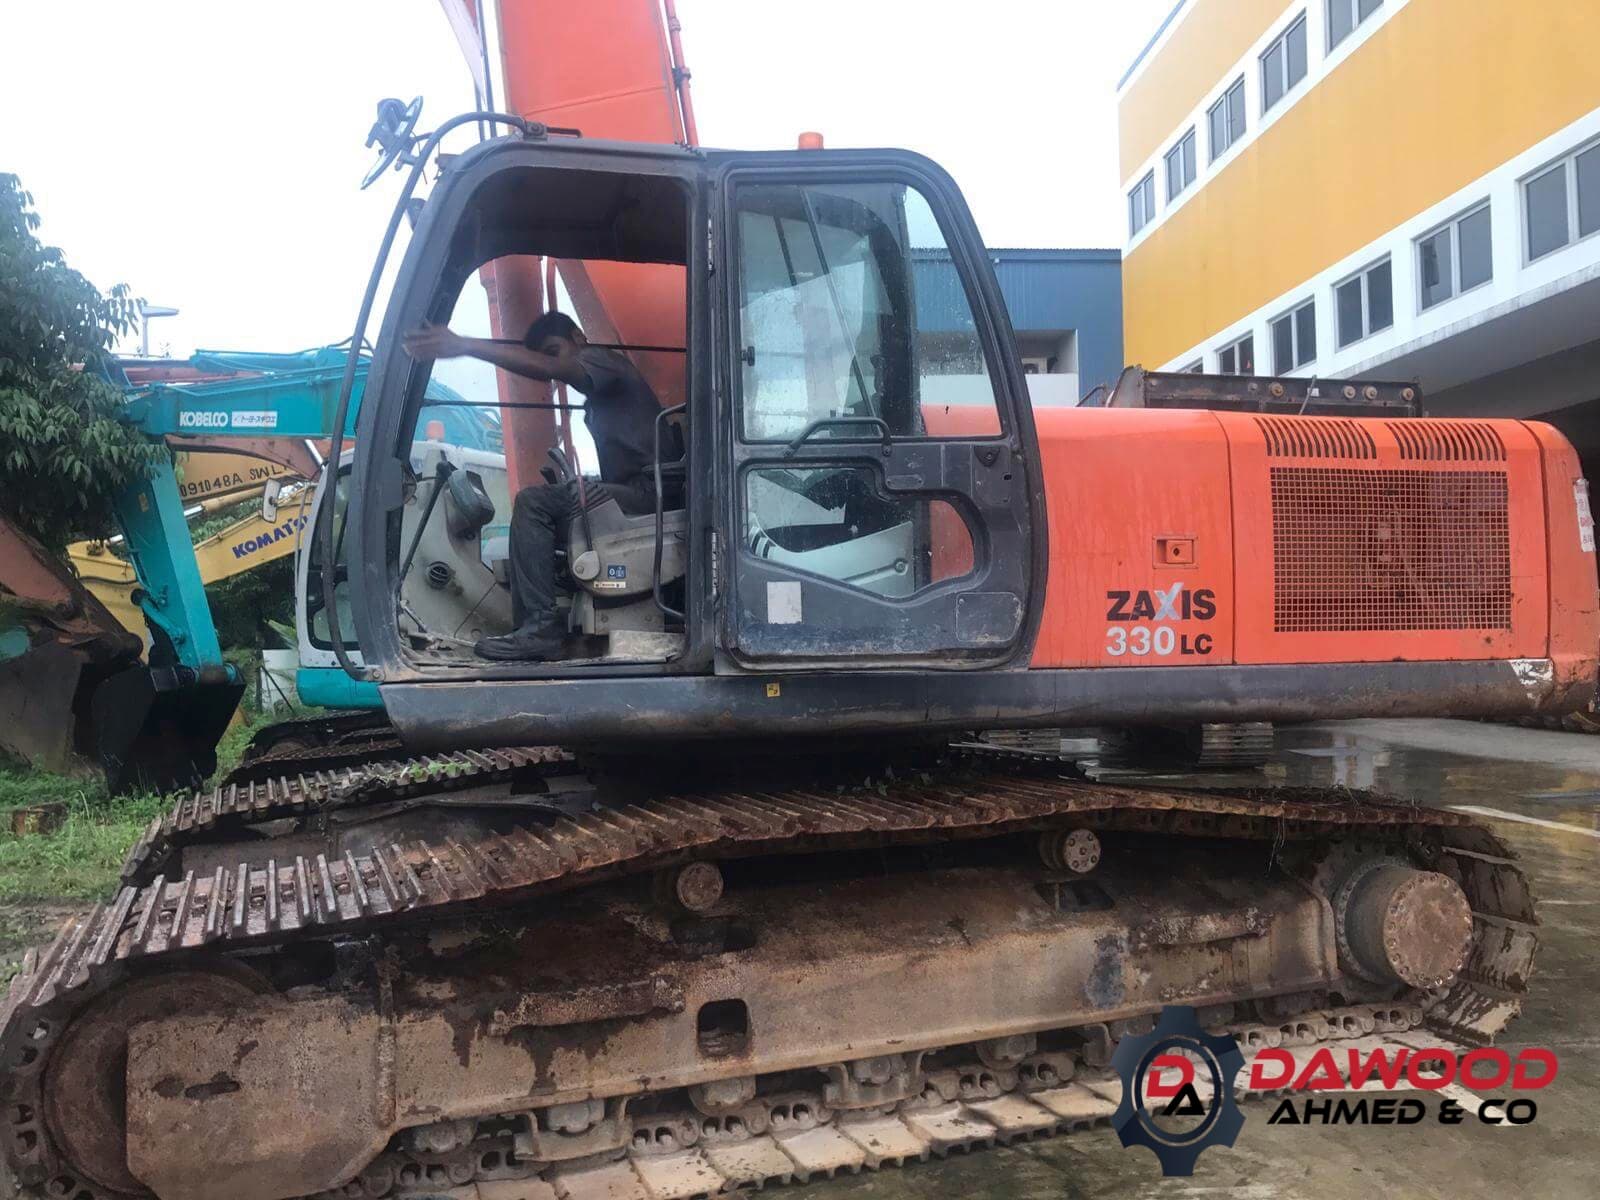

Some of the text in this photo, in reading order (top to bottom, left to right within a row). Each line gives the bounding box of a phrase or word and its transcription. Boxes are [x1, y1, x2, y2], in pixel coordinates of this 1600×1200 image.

[179, 411, 228, 427] KOBELCO
[1106, 581, 1217, 621] ZAXIS
[1106, 626, 1213, 656] 330 LC
